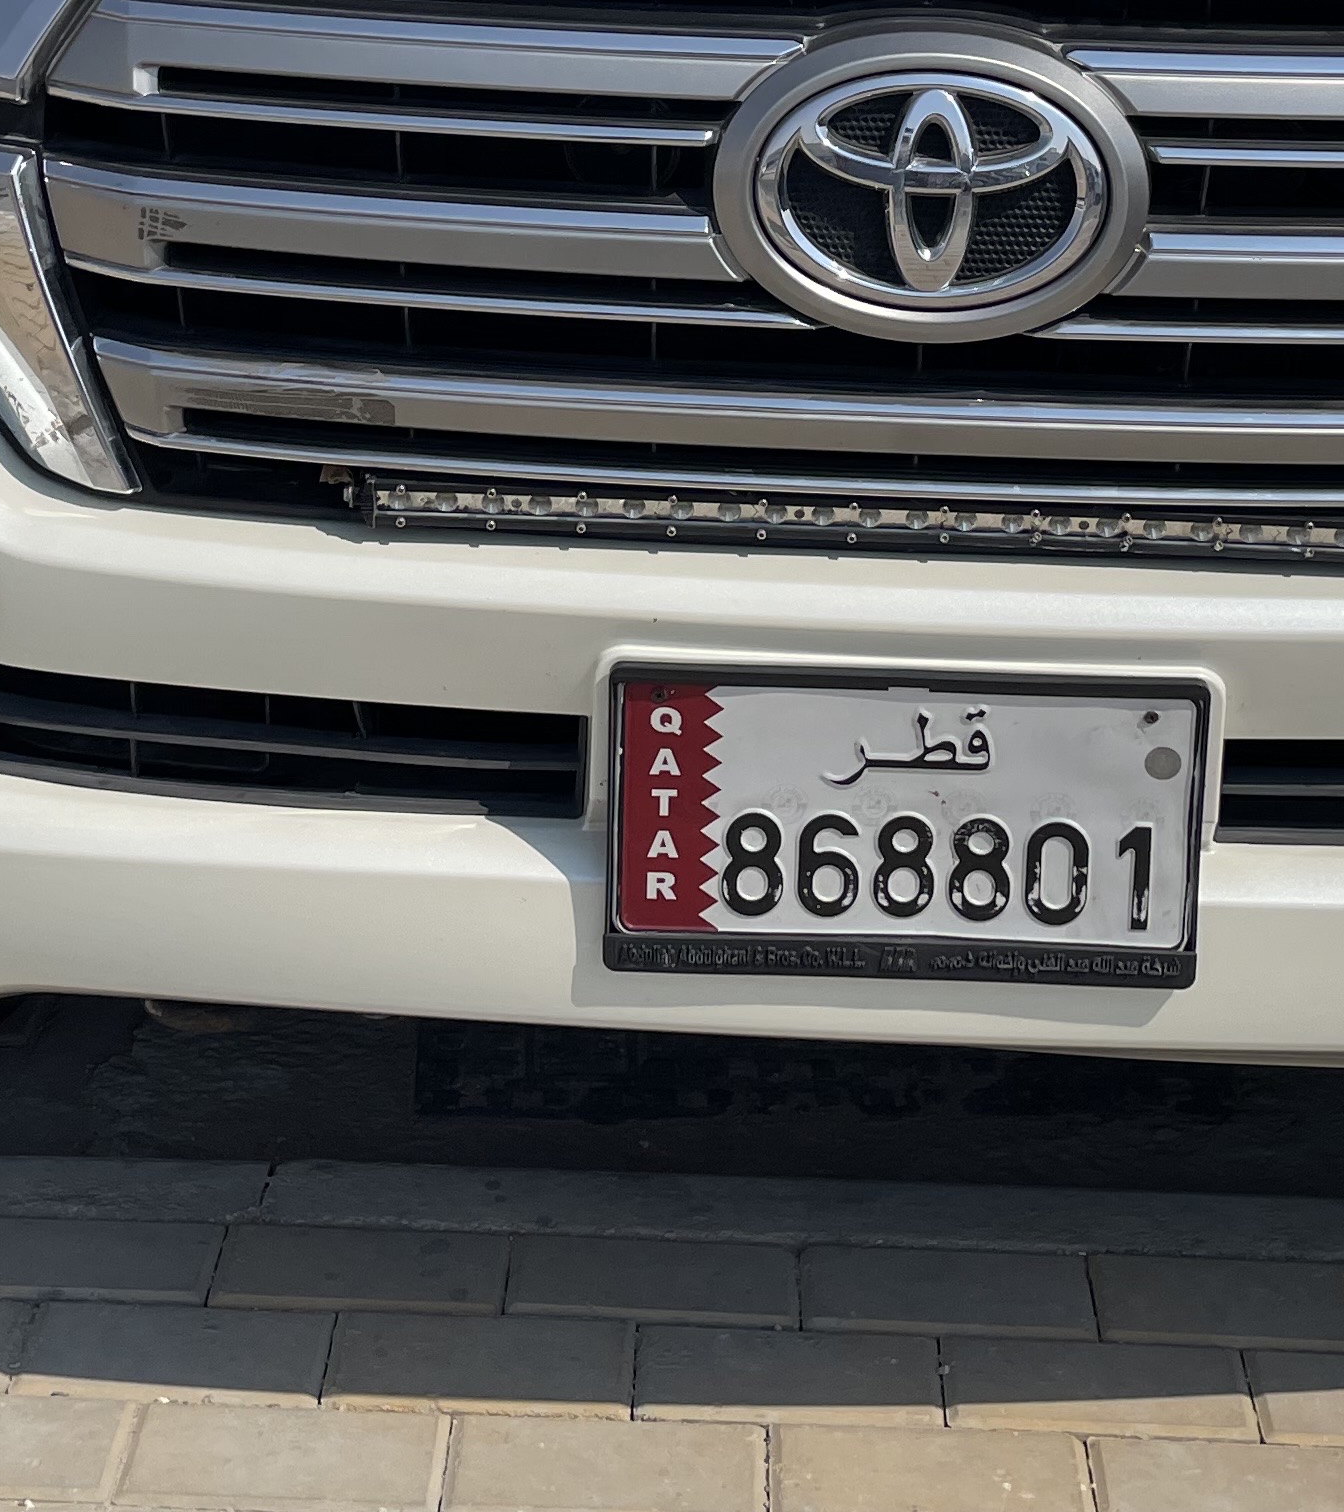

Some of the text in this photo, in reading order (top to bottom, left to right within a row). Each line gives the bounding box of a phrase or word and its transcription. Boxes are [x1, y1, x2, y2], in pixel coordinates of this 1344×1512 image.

[646, 707, 683, 901] QATAR
[823, 704, 992, 786] قطر
[722, 811, 1153, 932] 868801
